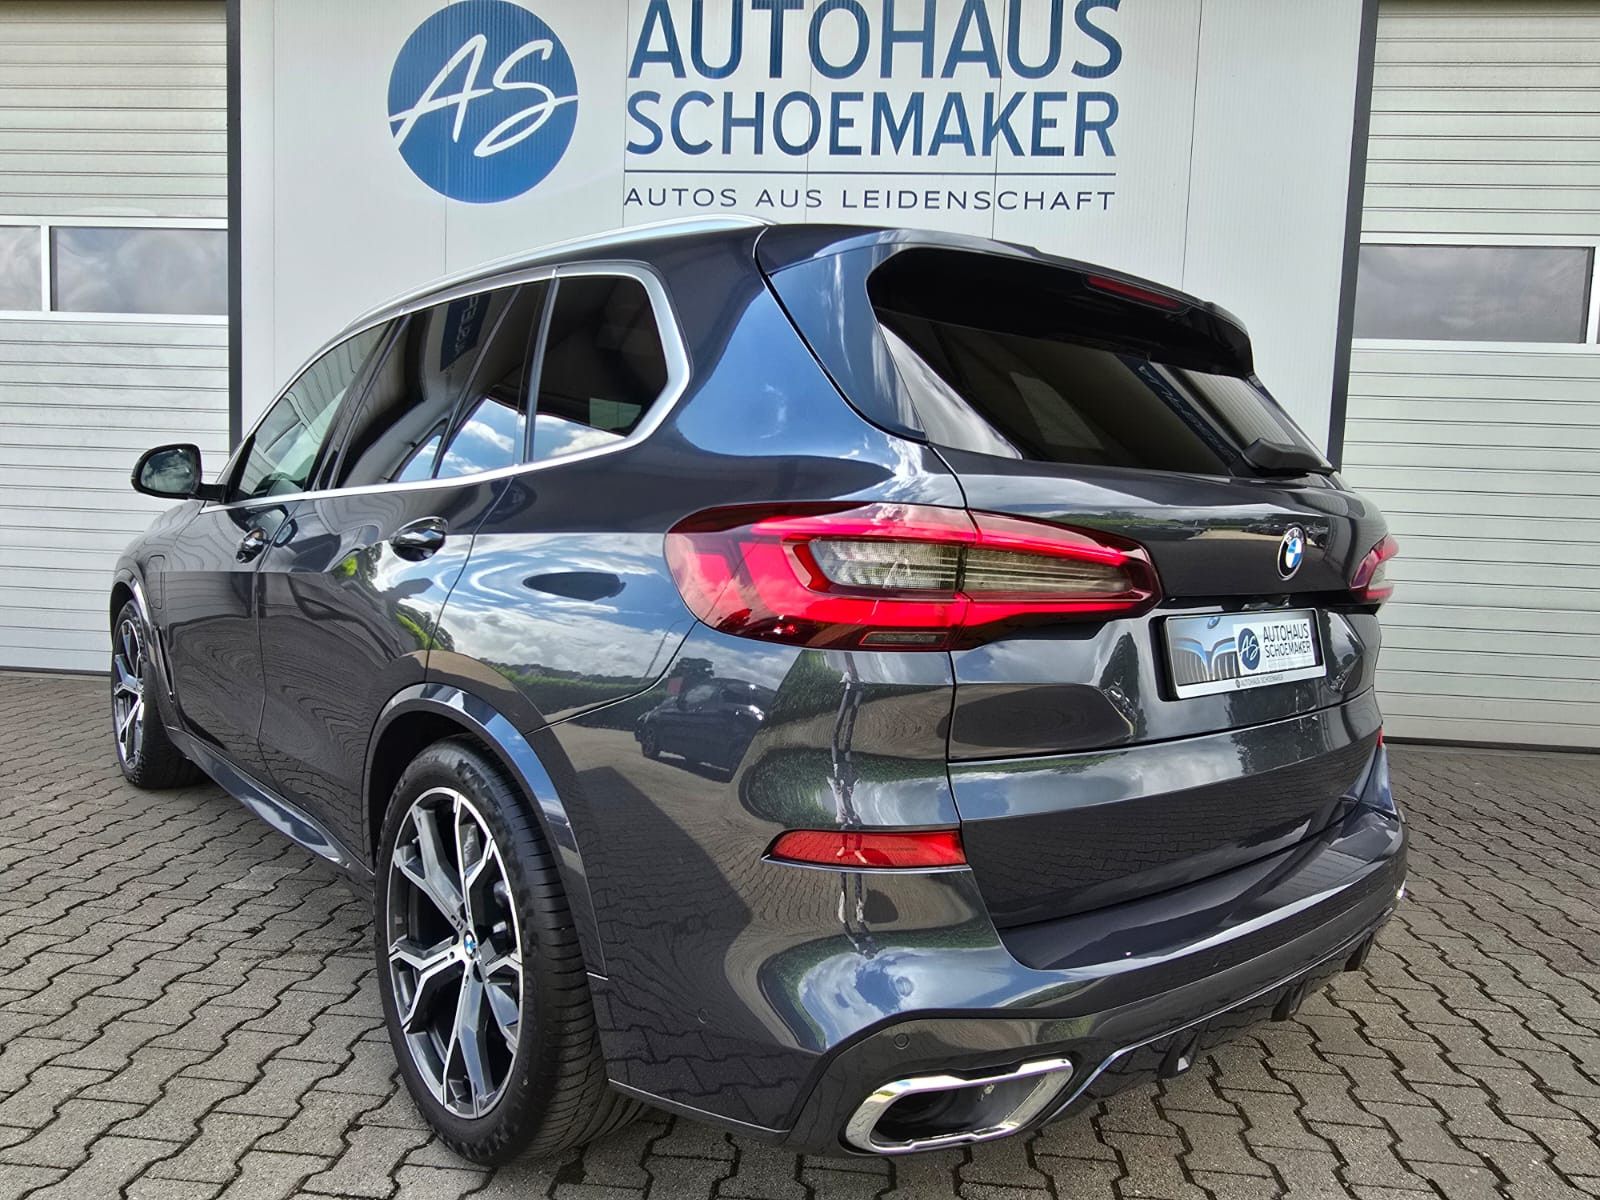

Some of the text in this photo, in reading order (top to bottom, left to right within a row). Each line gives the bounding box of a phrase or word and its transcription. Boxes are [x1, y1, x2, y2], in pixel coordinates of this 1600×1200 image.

[627, 0, 1123, 80] AUTOHAUS
[389, 33, 578, 158] AS
[626, 90, 1119, 157] SCHOEMAKER
[624, 187, 1116, 211] AUTOS AUS LEIDENSCHAFT
[1263, 623, 1309, 643] AUTOHAUS
[1264, 640, 1312, 658] SCHOEMAKER
